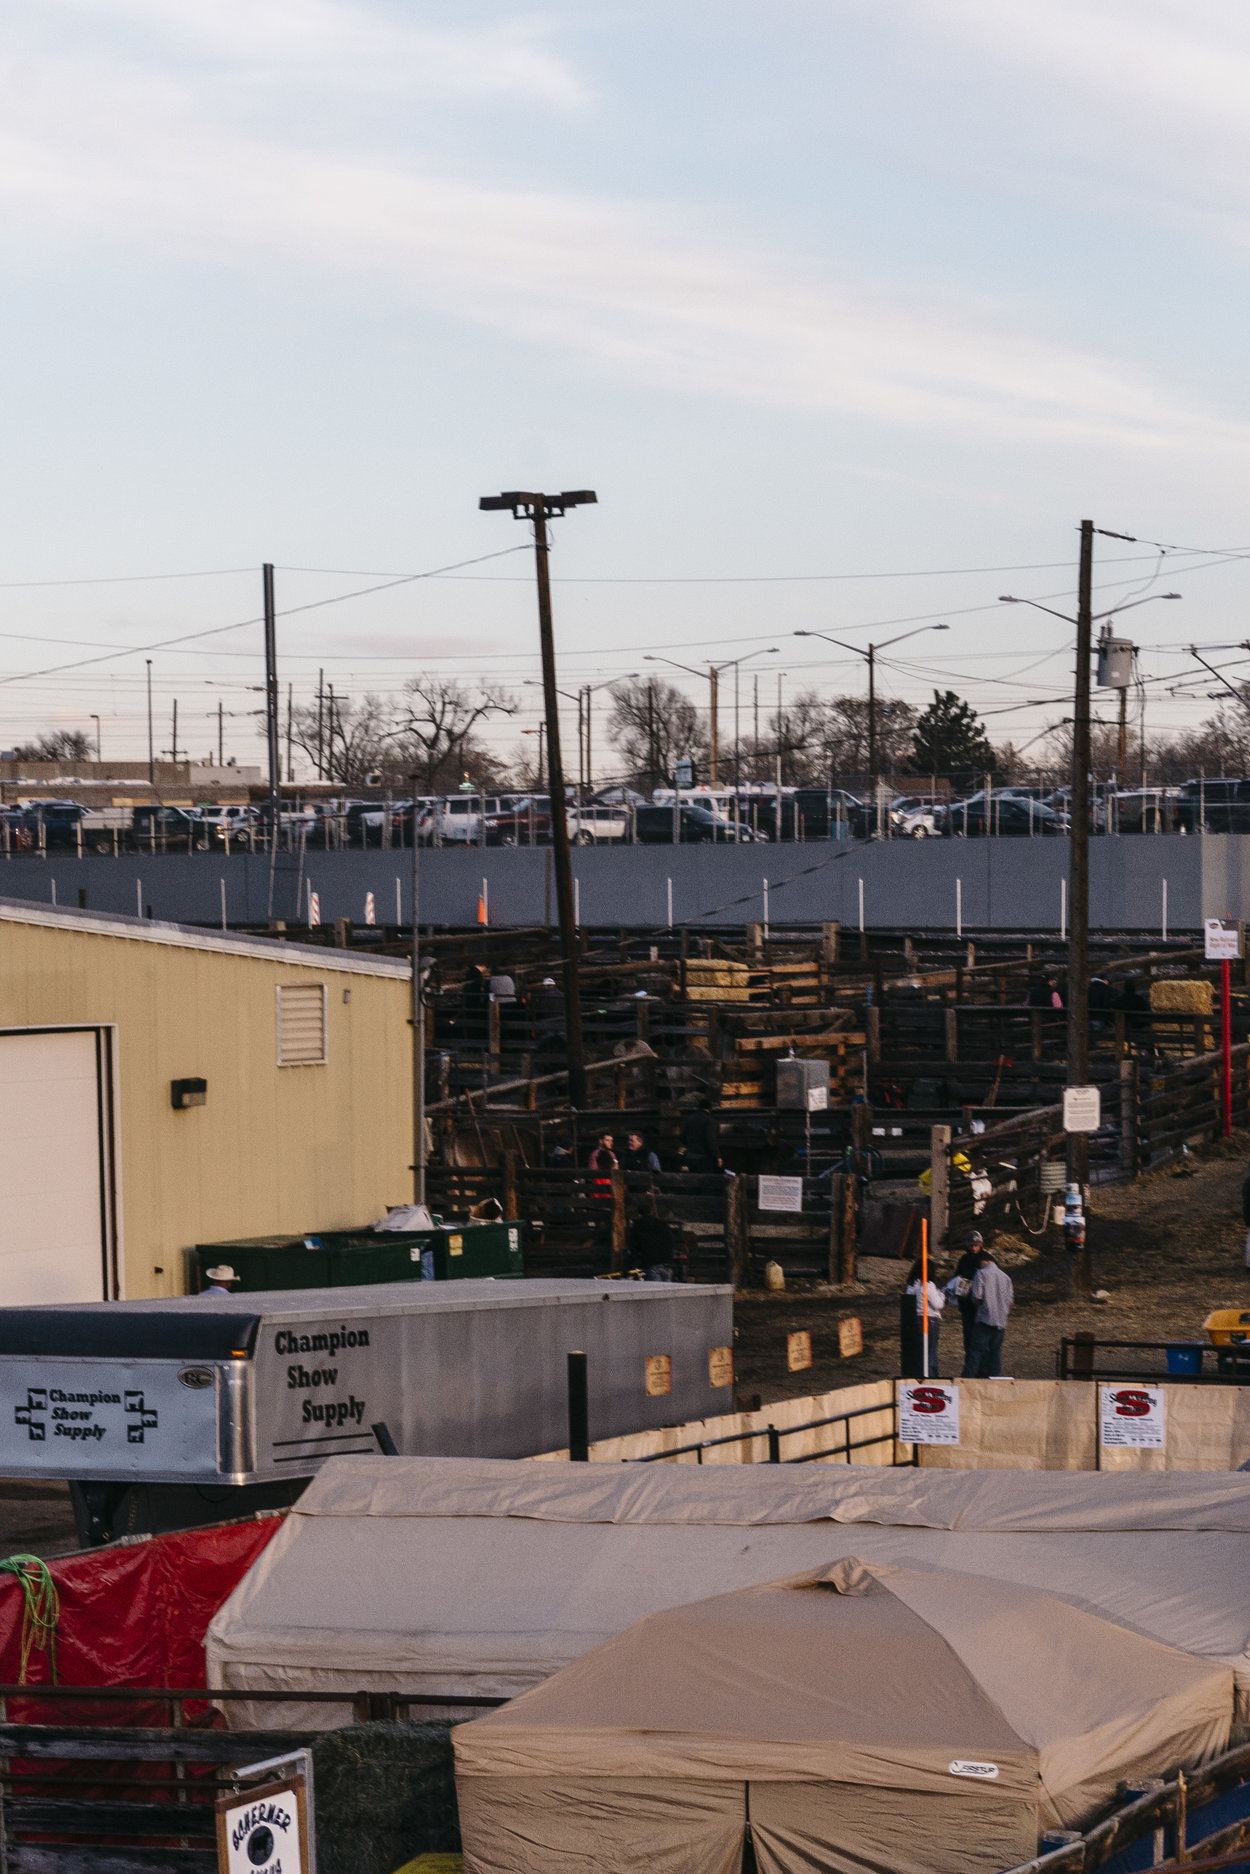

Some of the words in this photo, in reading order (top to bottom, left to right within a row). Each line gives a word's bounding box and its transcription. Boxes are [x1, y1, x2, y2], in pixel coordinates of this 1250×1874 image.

[274, 1325, 370, 1357] Champion
[286, 1364, 339, 1390] Show
[48, 1388, 122, 1406] Champion
[51, 1407, 93, 1421] Show
[301, 1396, 366, 1428] Supply
[53, 1423, 106, 1441] Supply
